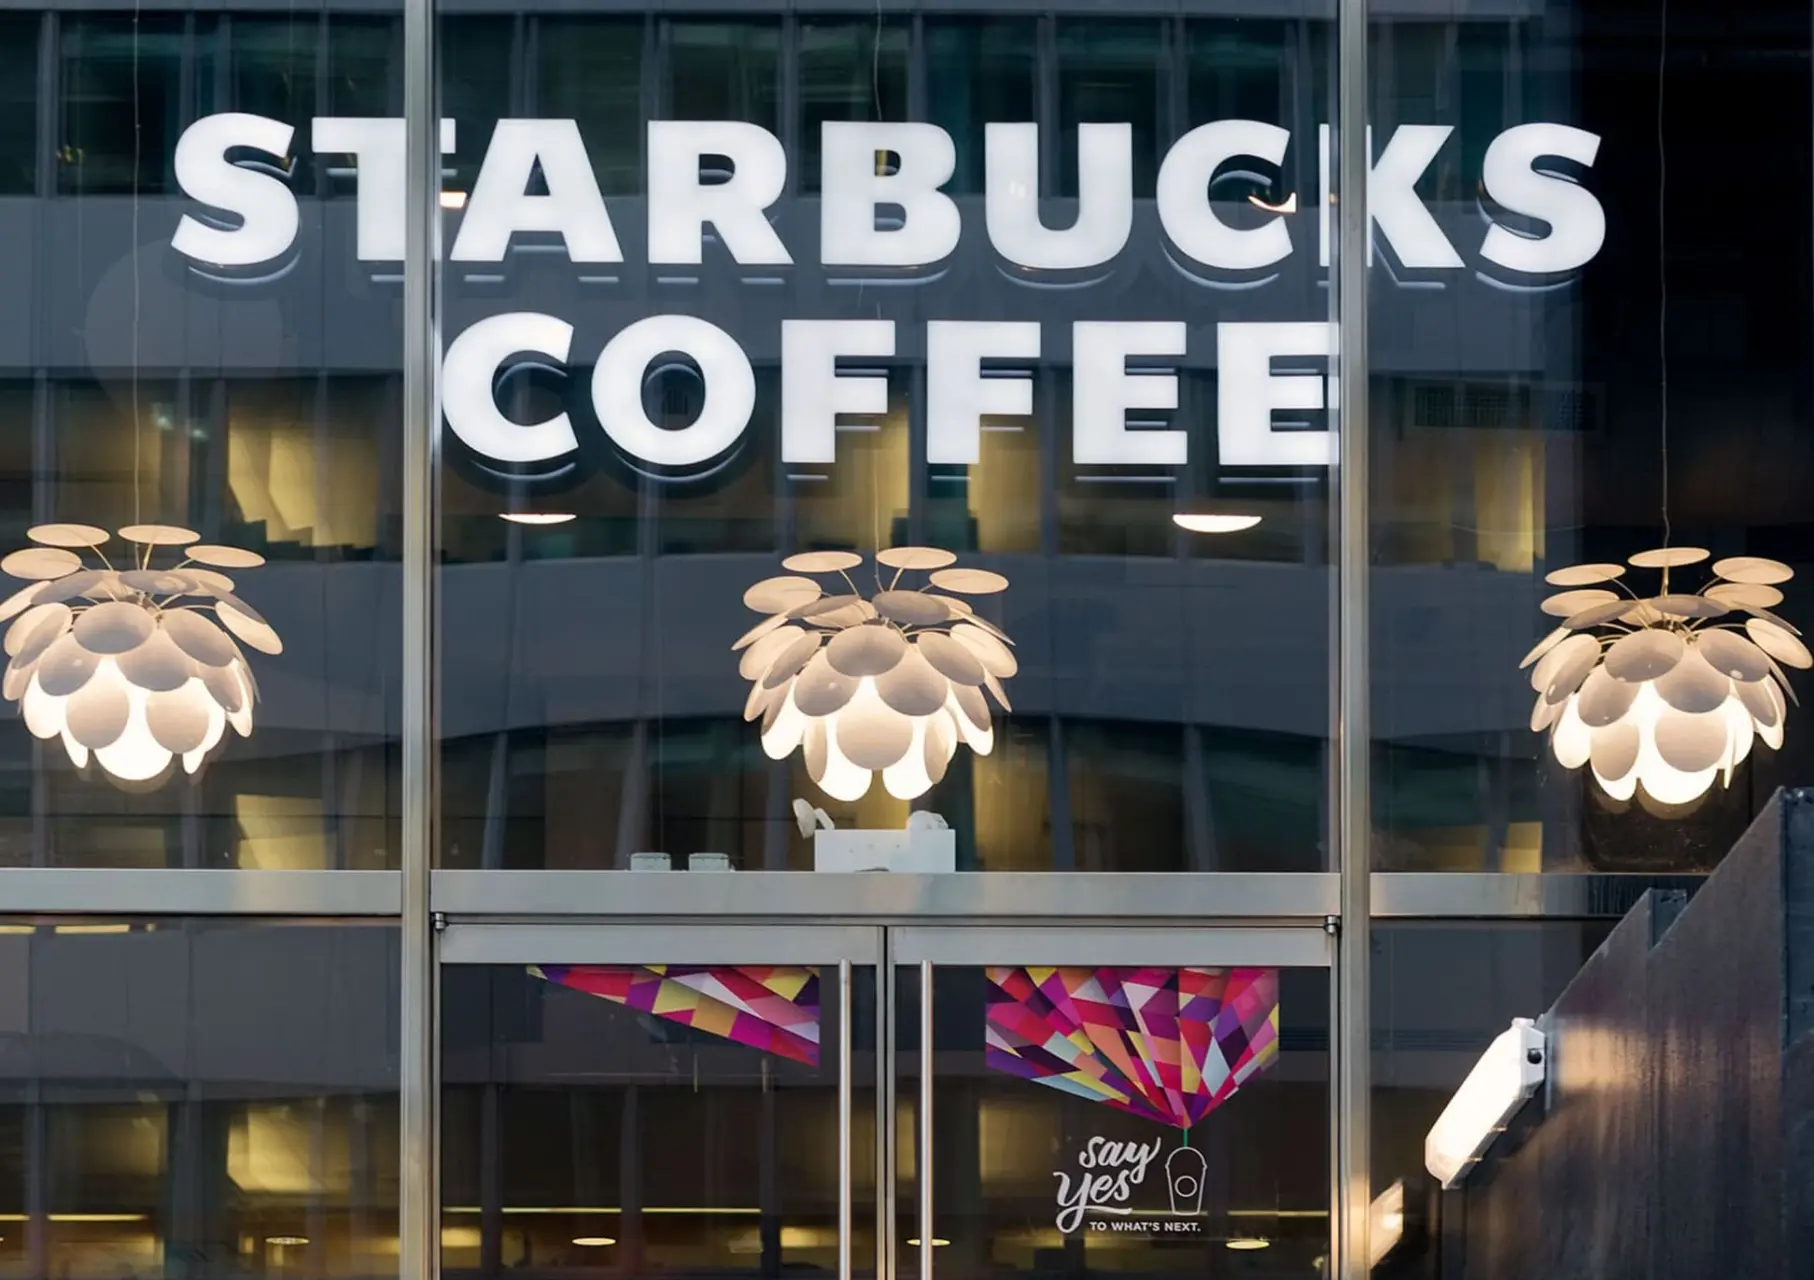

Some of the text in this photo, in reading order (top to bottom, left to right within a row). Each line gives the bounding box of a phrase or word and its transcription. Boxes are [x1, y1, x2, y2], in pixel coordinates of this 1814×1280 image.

[171, 112, 1606, 273] STARBUCKS
[441, 312, 1340, 466] COFFEE
[1079, 1136, 1161, 1184] say
[1052, 1169, 1133, 1233] yes
[1089, 1222, 1201, 1232] TO WHAT'S NEXT.
